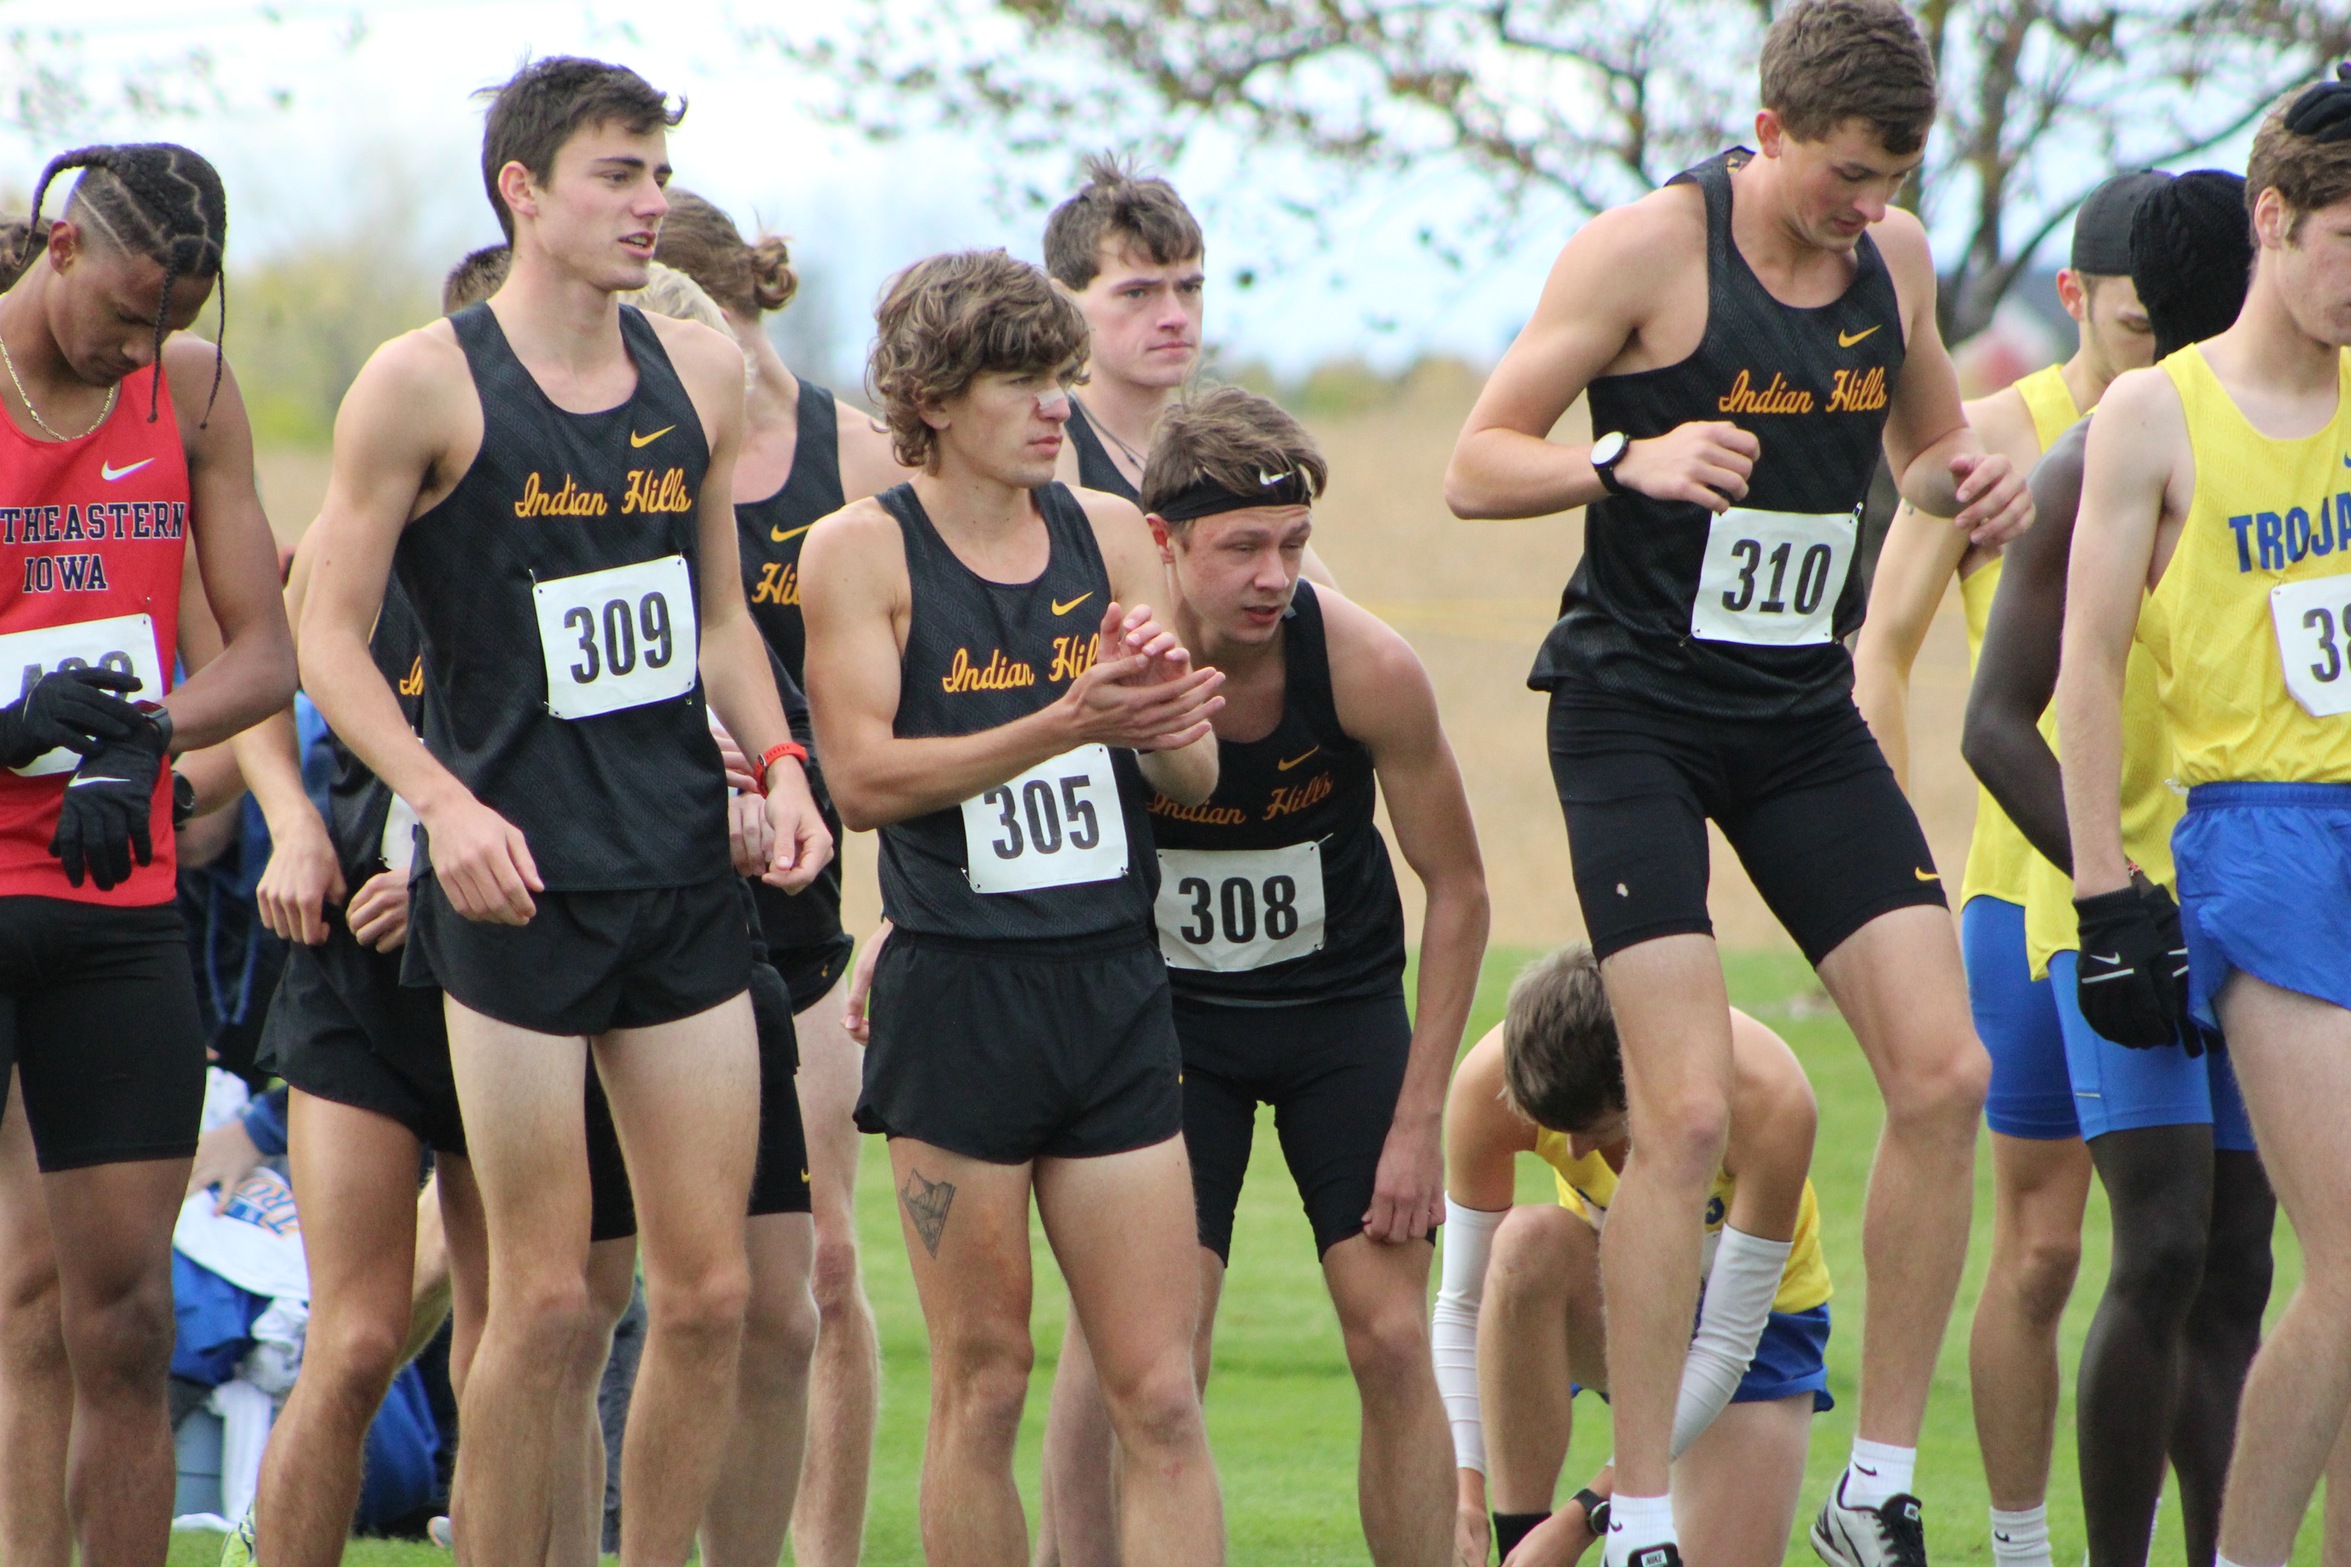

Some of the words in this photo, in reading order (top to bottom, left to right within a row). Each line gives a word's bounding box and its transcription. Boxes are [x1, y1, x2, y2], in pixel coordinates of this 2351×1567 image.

[1718, 369, 1814, 413] Indian
[1824, 366, 1888, 412] Hills
[514, 472, 608, 518] Indian
[621, 467, 692, 514] Hills
[0, 501, 186, 544] THEASTERN
[22, 553, 109, 593] IOWA
[751, 562, 801, 605] Hi
[1721, 538, 1832, 616] 310
[563, 591, 673, 685] 309
[2302, 602, 2351, 683] 3
[942, 648, 1035, 693] Indian
[983, 774, 1100, 860] 305
[1262, 770, 1334, 821] Hills
[1178, 874, 1299, 945] 308
